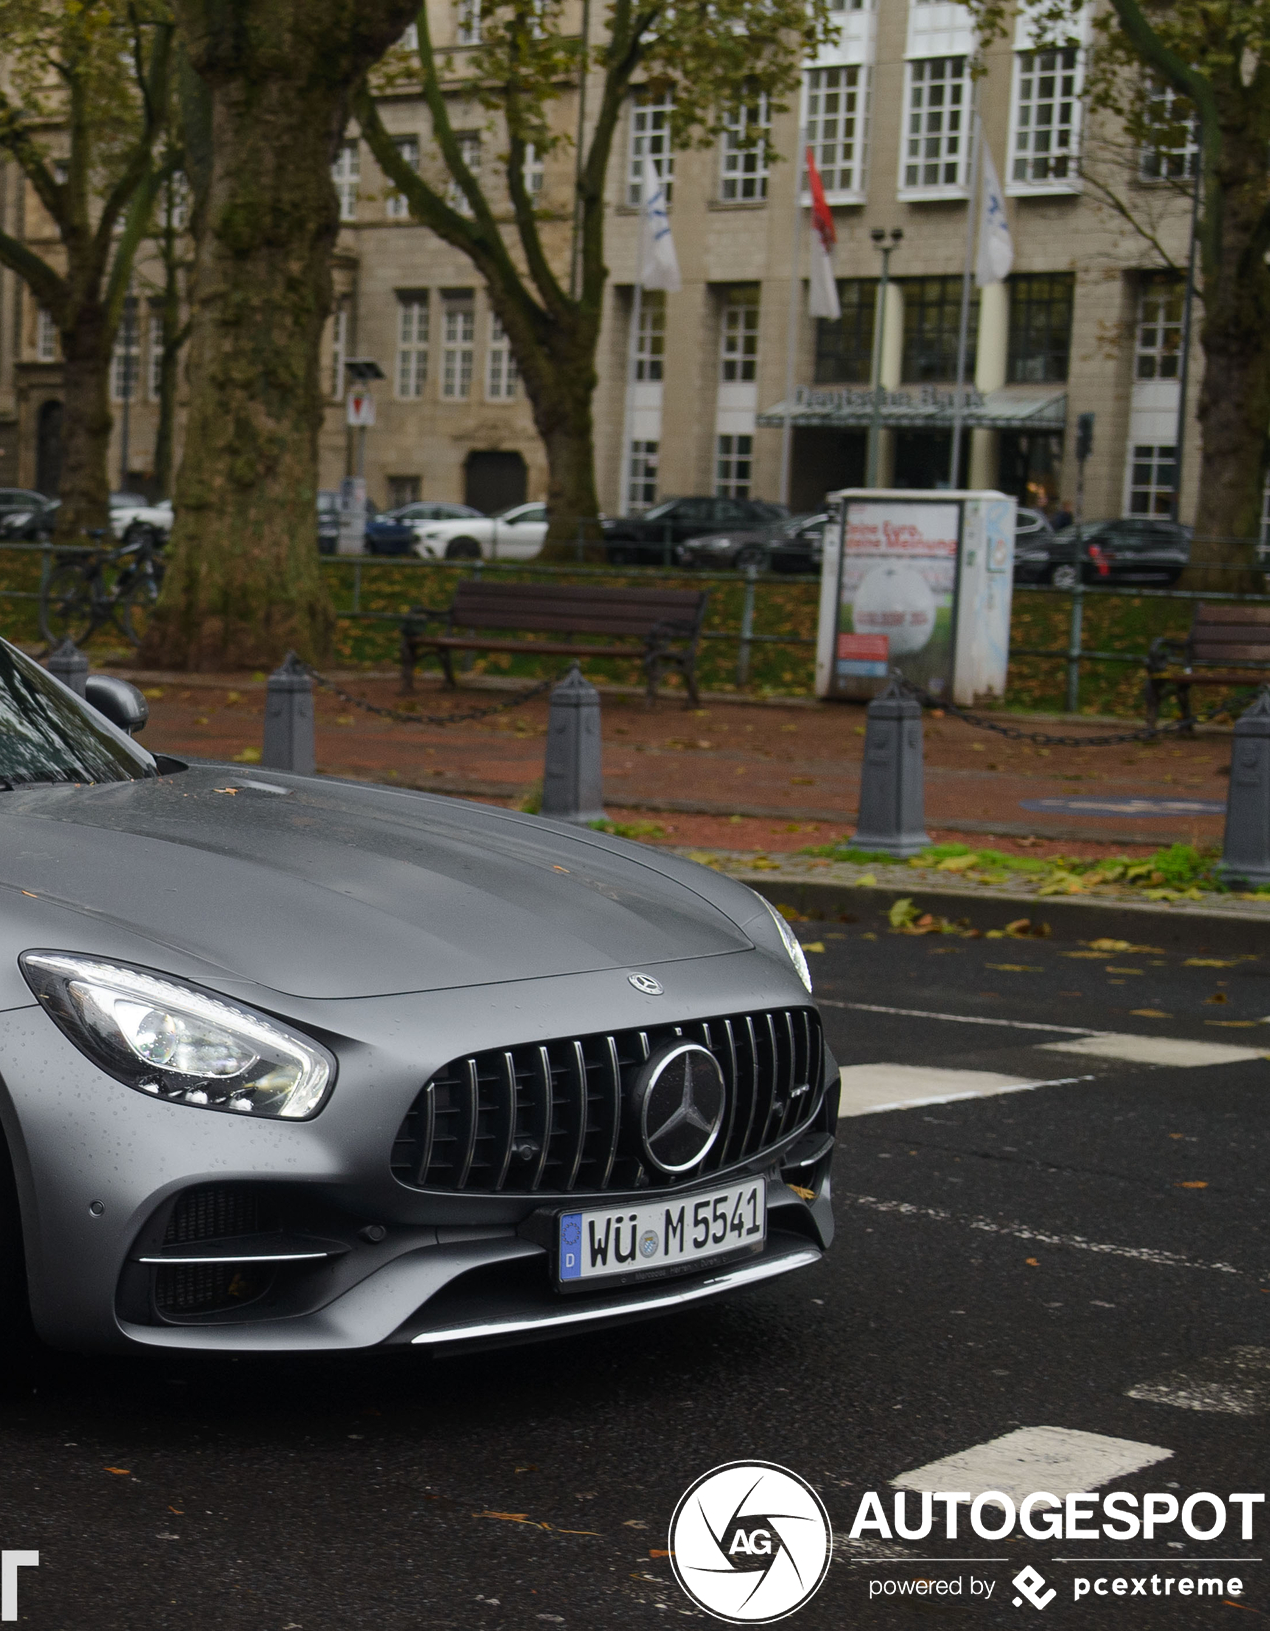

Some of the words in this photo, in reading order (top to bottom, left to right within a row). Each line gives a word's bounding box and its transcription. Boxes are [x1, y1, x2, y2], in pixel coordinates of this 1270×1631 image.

[588, 1213, 637, 1268] WÜ
[664, 1205, 685, 1256] M
[692, 1187, 761, 1249] 5541
[565, 1253, 575, 1268] D
